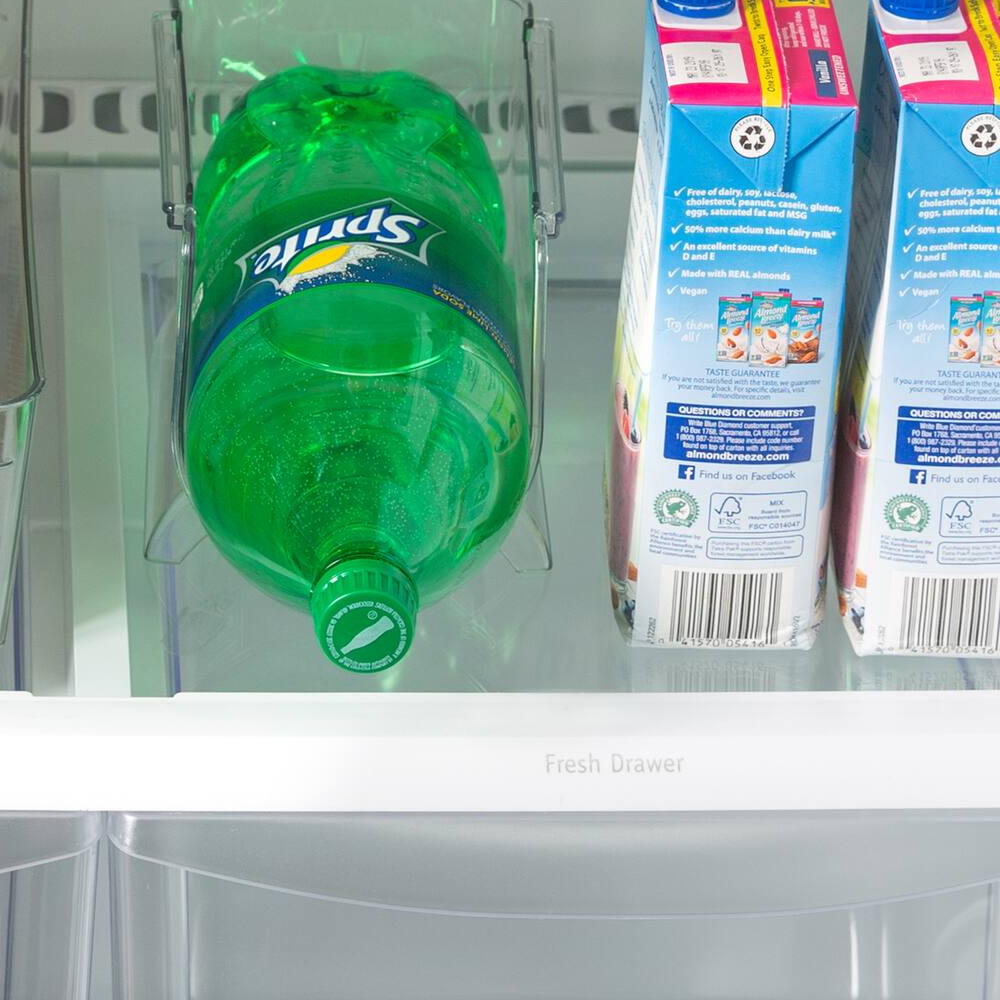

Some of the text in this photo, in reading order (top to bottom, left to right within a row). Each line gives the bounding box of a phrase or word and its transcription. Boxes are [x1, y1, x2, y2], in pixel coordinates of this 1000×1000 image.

[687, 188, 705, 196] Free
[719, 188, 743, 197] dairy,
[745, 190, 762, 198] soy,
[920, 189, 939, 197] Free
[940, 188, 950, 196] of
[951, 188, 974, 196] dairy,
[687, 198, 842, 213] cholesterol, peanuts, casein, gluten,
[686, 208, 807, 219] eggs, saturated fat and MSG
[685, 225, 703, 233] 50%
[706, 226, 727, 234] more
[730, 225, 763, 234] calcium
[766, 227, 785, 235] than
[787, 228, 810, 239] dairy
[917, 226, 936, 235] 50%
[961, 224, 994, 233] calcium
[253, 206, 420, 275] Sprite
[698, 243, 736, 252] excellent
[768, 244, 777, 253] of
[780, 245, 817, 255] vitamins
[916, 244, 927, 252] An
[929, 243, 967, 251] excellent
[681, 269, 791, 280] Made with REAL almonds
[680, 287, 707, 296] Vegan
[912, 288, 939, 297] Vegan
[432, 289, 466, 310] SODA
[664, 317, 713, 332] Try them
[705, 368, 780, 377] TASTE GUARANTEE
[679, 406, 804, 418] QUESTIONS OR COMMENTS?
[910, 409, 977, 419] QUESTIONS OR
[686, 450, 789, 461] almondbreeze.com
[700, 469, 719, 479] Find
[751, 470, 796, 481] Facebook
[545, 752, 684, 774] Fresh Drawer
